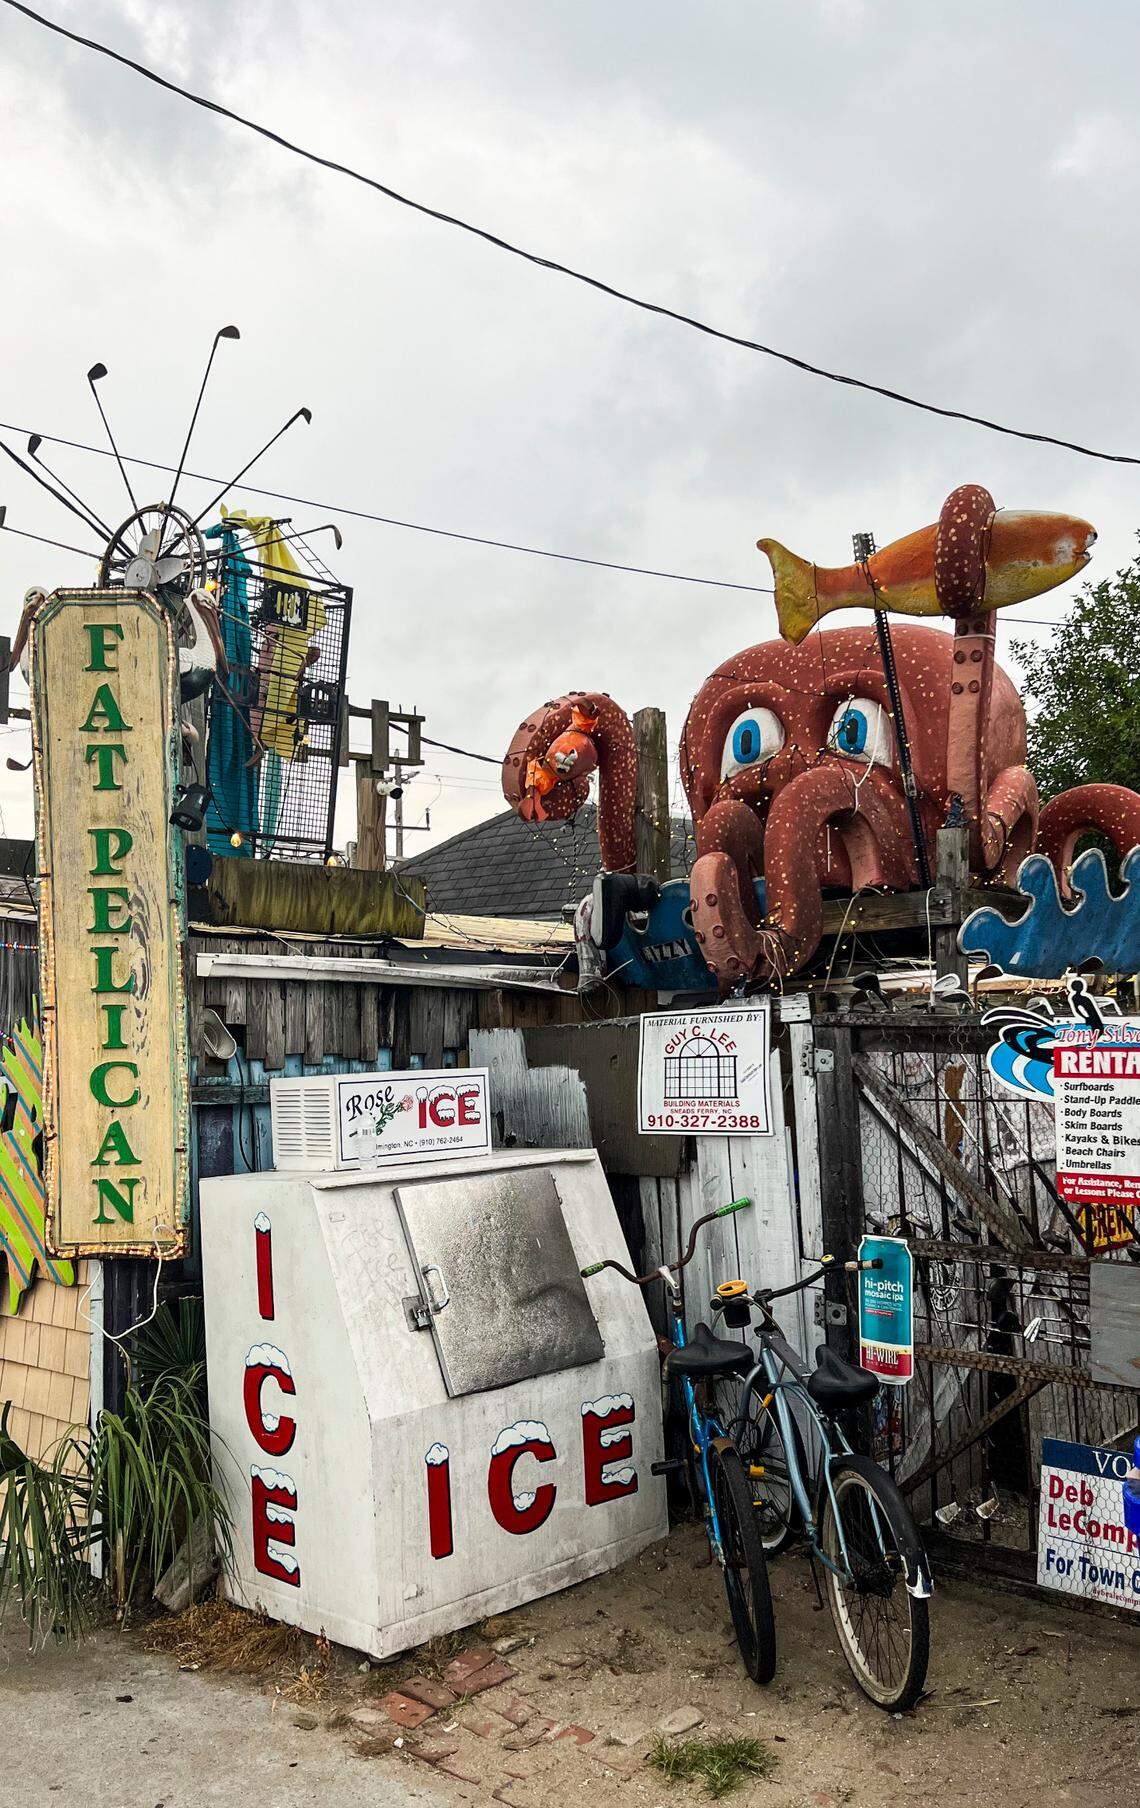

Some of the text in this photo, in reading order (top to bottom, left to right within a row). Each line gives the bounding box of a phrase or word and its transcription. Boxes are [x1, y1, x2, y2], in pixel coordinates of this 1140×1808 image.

[79, 623, 143, 1225] FAT PELICAN
[647, 1018, 687, 1027] MATERIAL
[690, 1014, 743, 1024] FURNISHED
[665, 1026, 737, 1054] GUY C. LEE
[1055, 1024, 1099, 1050] Tony
[1064, 1082, 1115, 1091] Surfboards
[346, 1084, 480, 1128] Rose ICE
[1064, 1095, 1106, 1106] Stand-Up
[1064, 1108, 1122, 1118] Body Boards
[648, 1115, 760, 1128] 910-327-2388
[1065, 1121, 1123, 1131] Skim Boards
[419, 1138, 435, 1148] (910)
[1065, 1134, 1098, 1144] Kayaks
[1101, 1135, 1109, 1144] &
[1066, 1147, 1126, 1157] Beach Chairs
[1066, 1160, 1112, 1170] Umbrellas
[1062, 1177, 1076, 1185] For
[1078, 1177, 1122, 1189] Assistance,
[1075, 1187, 1106, 1196] Lessons
[1107, 1189, 1135, 1198] Please
[864, 1277, 904, 1293] hi-pitch
[865, 1290, 904, 1302] mosaic ipa
[866, 1345, 899, 1365] HI-WIRE
[244, 1212, 301, 1588] ICE
[425, 1393, 638, 1560] ICE
[1049, 1475, 1094, 1506] Deb
[1046, 1548, 1074, 1576] For
[1079, 1556, 1125, 1589] Town
